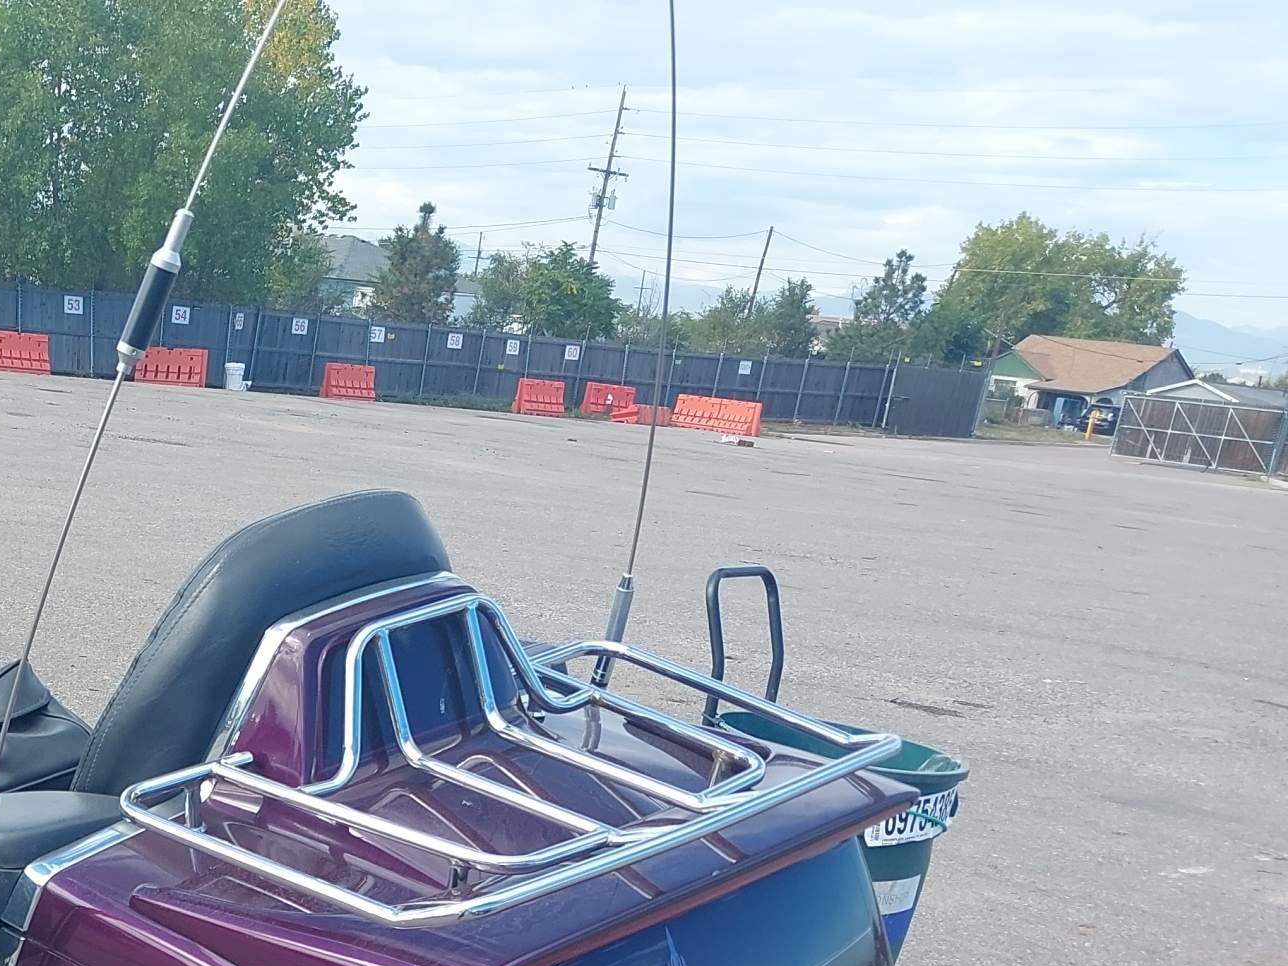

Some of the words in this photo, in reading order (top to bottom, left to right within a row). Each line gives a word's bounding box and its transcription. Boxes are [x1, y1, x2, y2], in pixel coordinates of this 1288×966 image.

[67, 298, 80, 311] 53
[175, 309, 187, 321] 54
[295, 319, 306, 332] 56
[371, 328, 382, 341] 57
[450, 335, 460, 347] 58
[508, 341, 518, 352] 59
[567, 347, 578, 358] 60
